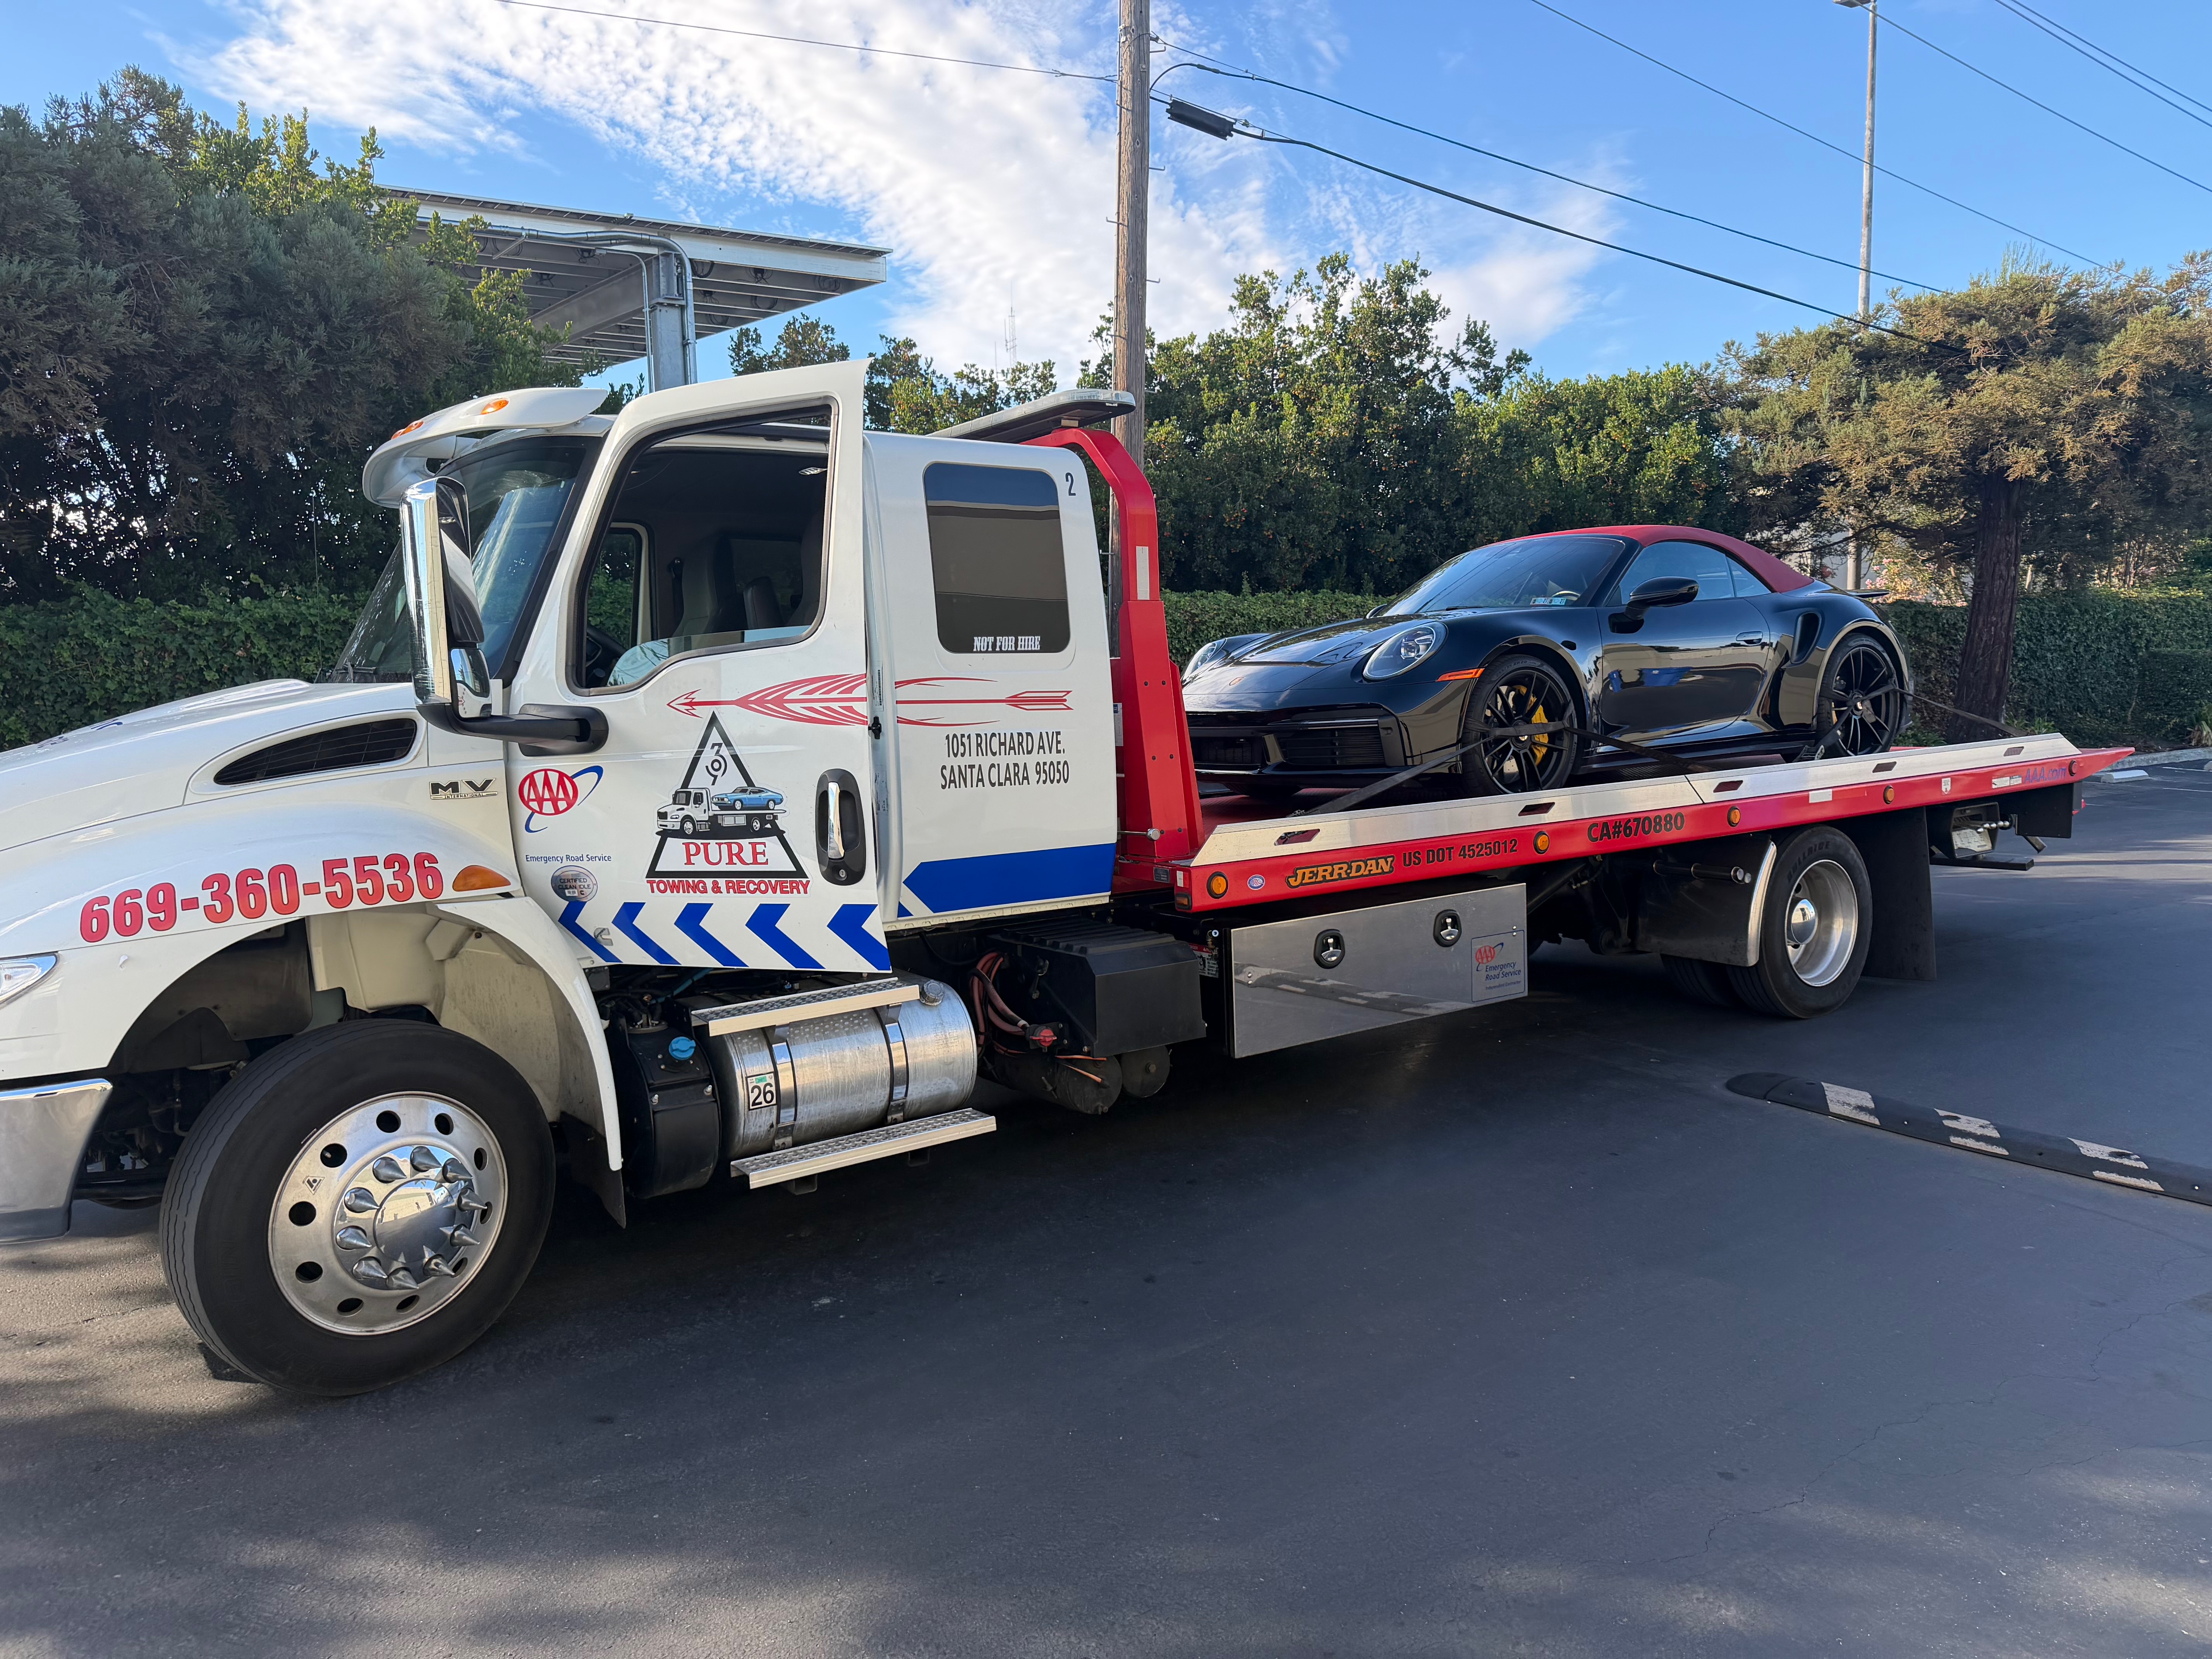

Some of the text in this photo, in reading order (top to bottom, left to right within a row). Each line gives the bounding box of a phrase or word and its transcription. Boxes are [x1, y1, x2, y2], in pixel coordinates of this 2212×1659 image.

[1065, 472, 1076, 496] 2
[973, 636, 1041, 651] NOT FOR HIRE
[945, 731, 1065, 757] 1051 RICHARD AVE.
[429, 778, 496, 795] MV
[941, 760, 1069, 790] SANTA CLARA 95050
[2025, 767, 2066, 784] AAA.com
[521, 769, 576, 815] AAA
[1588, 812, 1685, 842] CA#670880
[526, 855, 563, 864] Emergency
[682, 842, 768, 865] PURE
[1403, 838, 1517, 867] US DOT 4525012
[80, 852, 444, 943] 669-360-5536
[646, 879, 810, 894] TOWING & RECOVERY
[1475, 945, 1496, 964] AAA
[1486, 962, 1516, 972] Emergency
[1486, 969, 1521, 981] Road Service
[751, 1083, 774, 1106] 26
